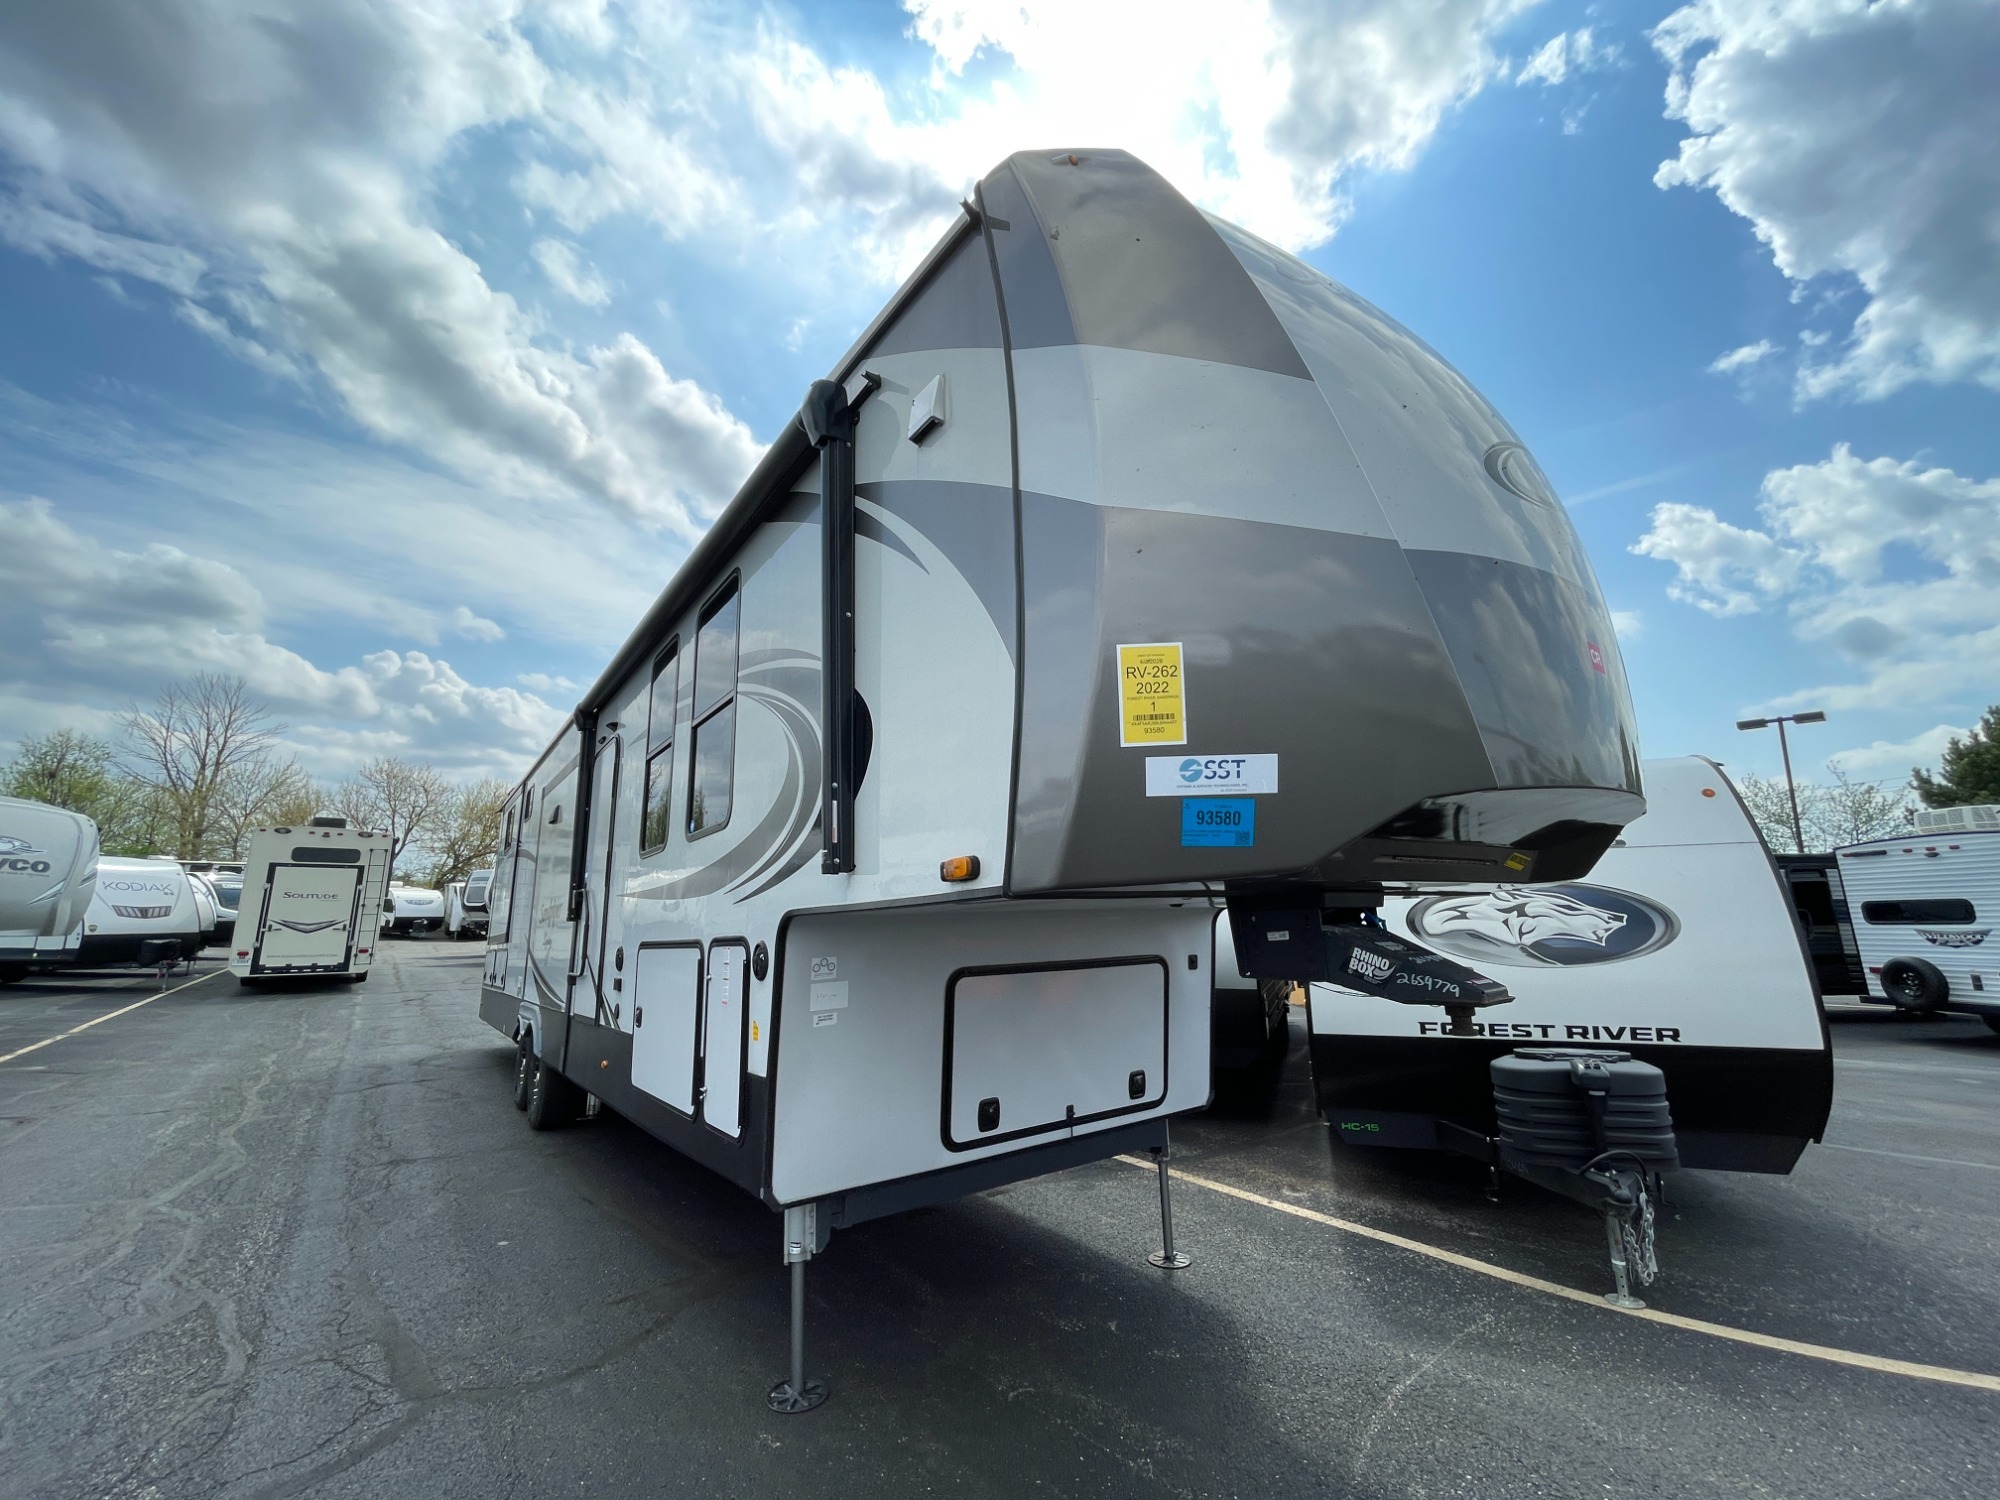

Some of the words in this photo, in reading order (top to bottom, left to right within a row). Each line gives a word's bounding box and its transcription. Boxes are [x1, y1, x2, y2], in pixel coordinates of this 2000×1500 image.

[1126, 665, 1178, 679] RV-262
[1136, 681, 1169, 694] 2022
[1151, 701, 1155, 711] 1
[1204, 759, 1246, 779] SST
[1196, 810, 1241, 826] 93580
[102, 881, 174, 892] KODIAK
[1352, 946, 1390, 971] RHINO
[1348, 957, 1375, 977] BOX
[1395, 972, 1461, 998] 2659779
[1563, 1025, 1682, 1043] RIVER
[1341, 1122, 1380, 1132] HC-15
